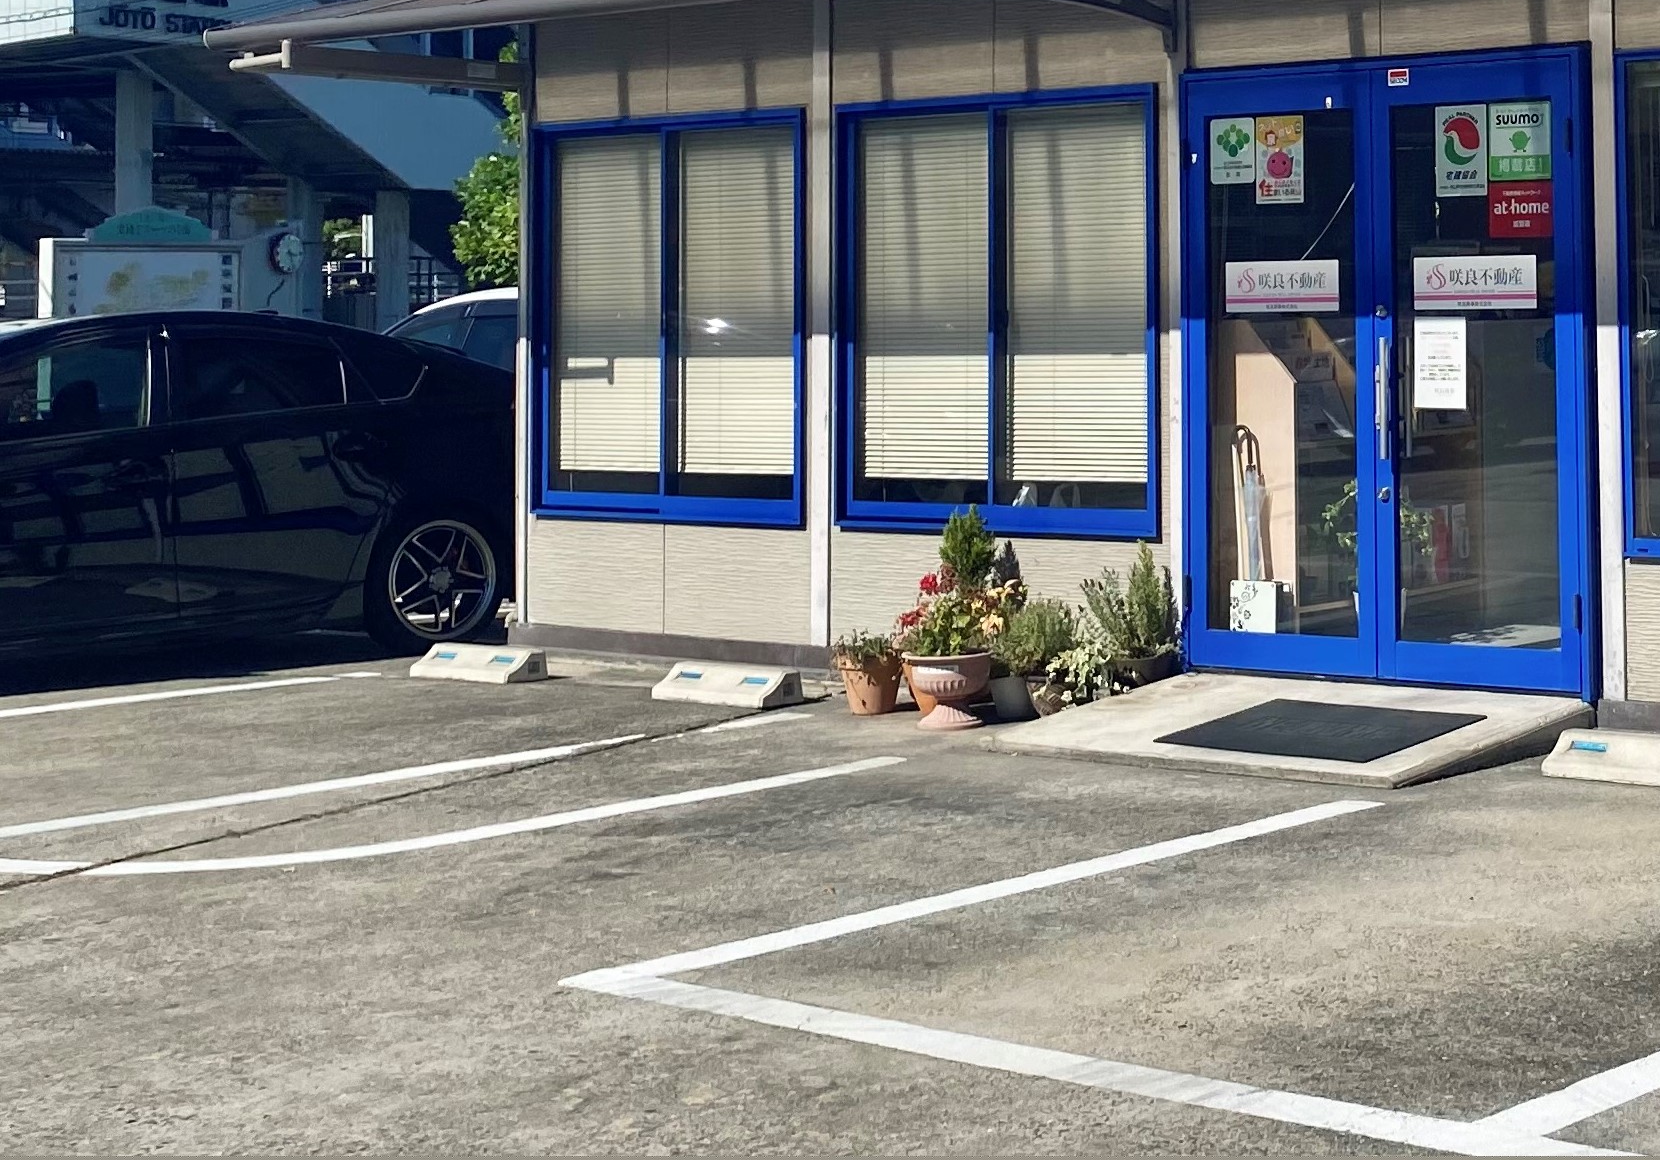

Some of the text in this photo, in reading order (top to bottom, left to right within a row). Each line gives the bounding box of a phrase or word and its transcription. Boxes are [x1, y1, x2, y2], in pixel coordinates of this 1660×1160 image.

[1258, 271, 1327, 290] 咲良不動産
[1449, 267, 1523, 286] 咲良不動産
